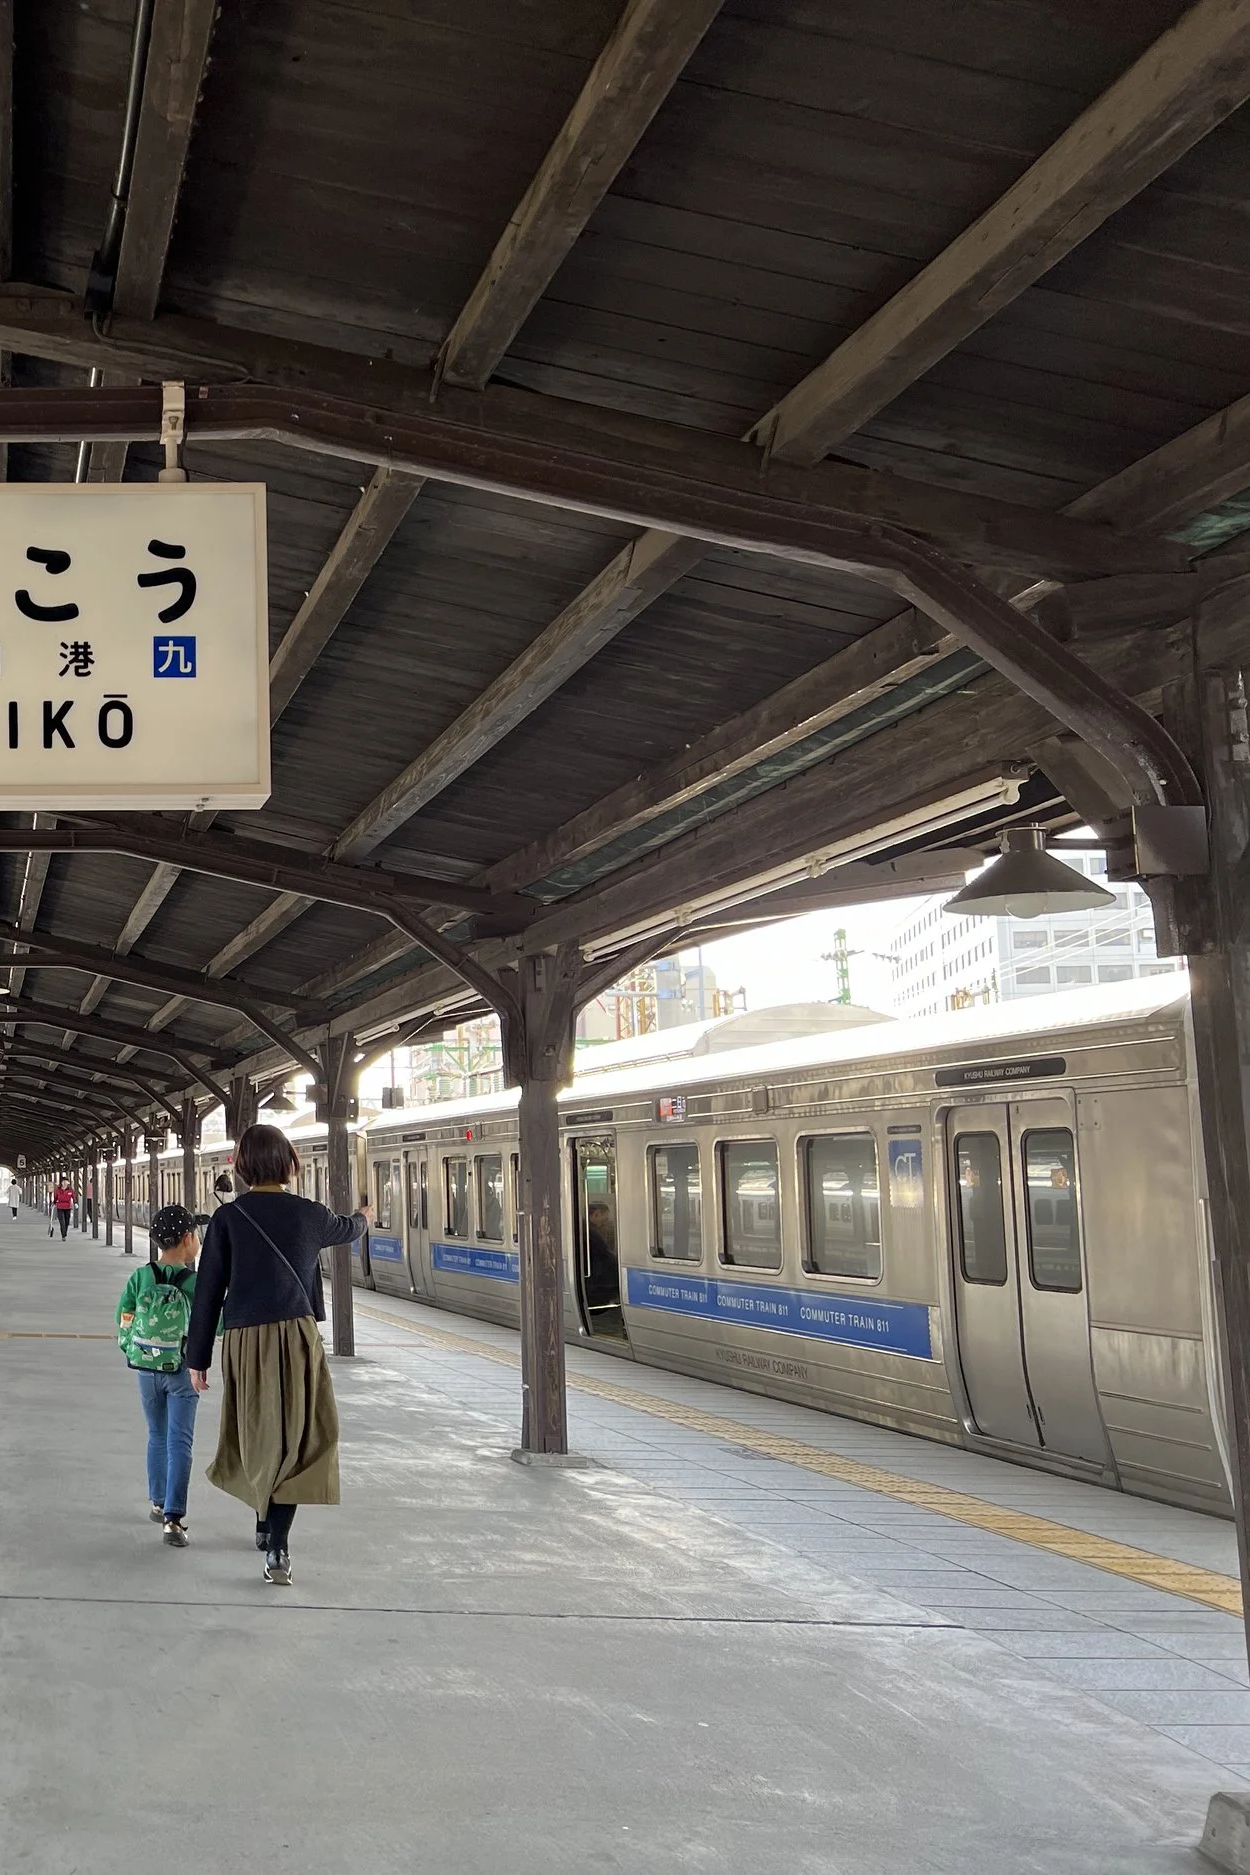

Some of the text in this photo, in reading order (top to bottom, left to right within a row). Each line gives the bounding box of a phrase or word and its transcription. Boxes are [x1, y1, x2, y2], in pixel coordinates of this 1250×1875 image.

[158, 640, 191, 673] 九
[1005, 1065, 1030, 1076] COMPANY
[648, 1283, 708, 1304] COMMUTER TRAIN 811
[717, 1294, 789, 1317] COMMUTER TRAIN 811
[800, 1306, 890, 1333] COMMUTER TRAIN 811
[772, 1360, 808, 1379] COMPANY
